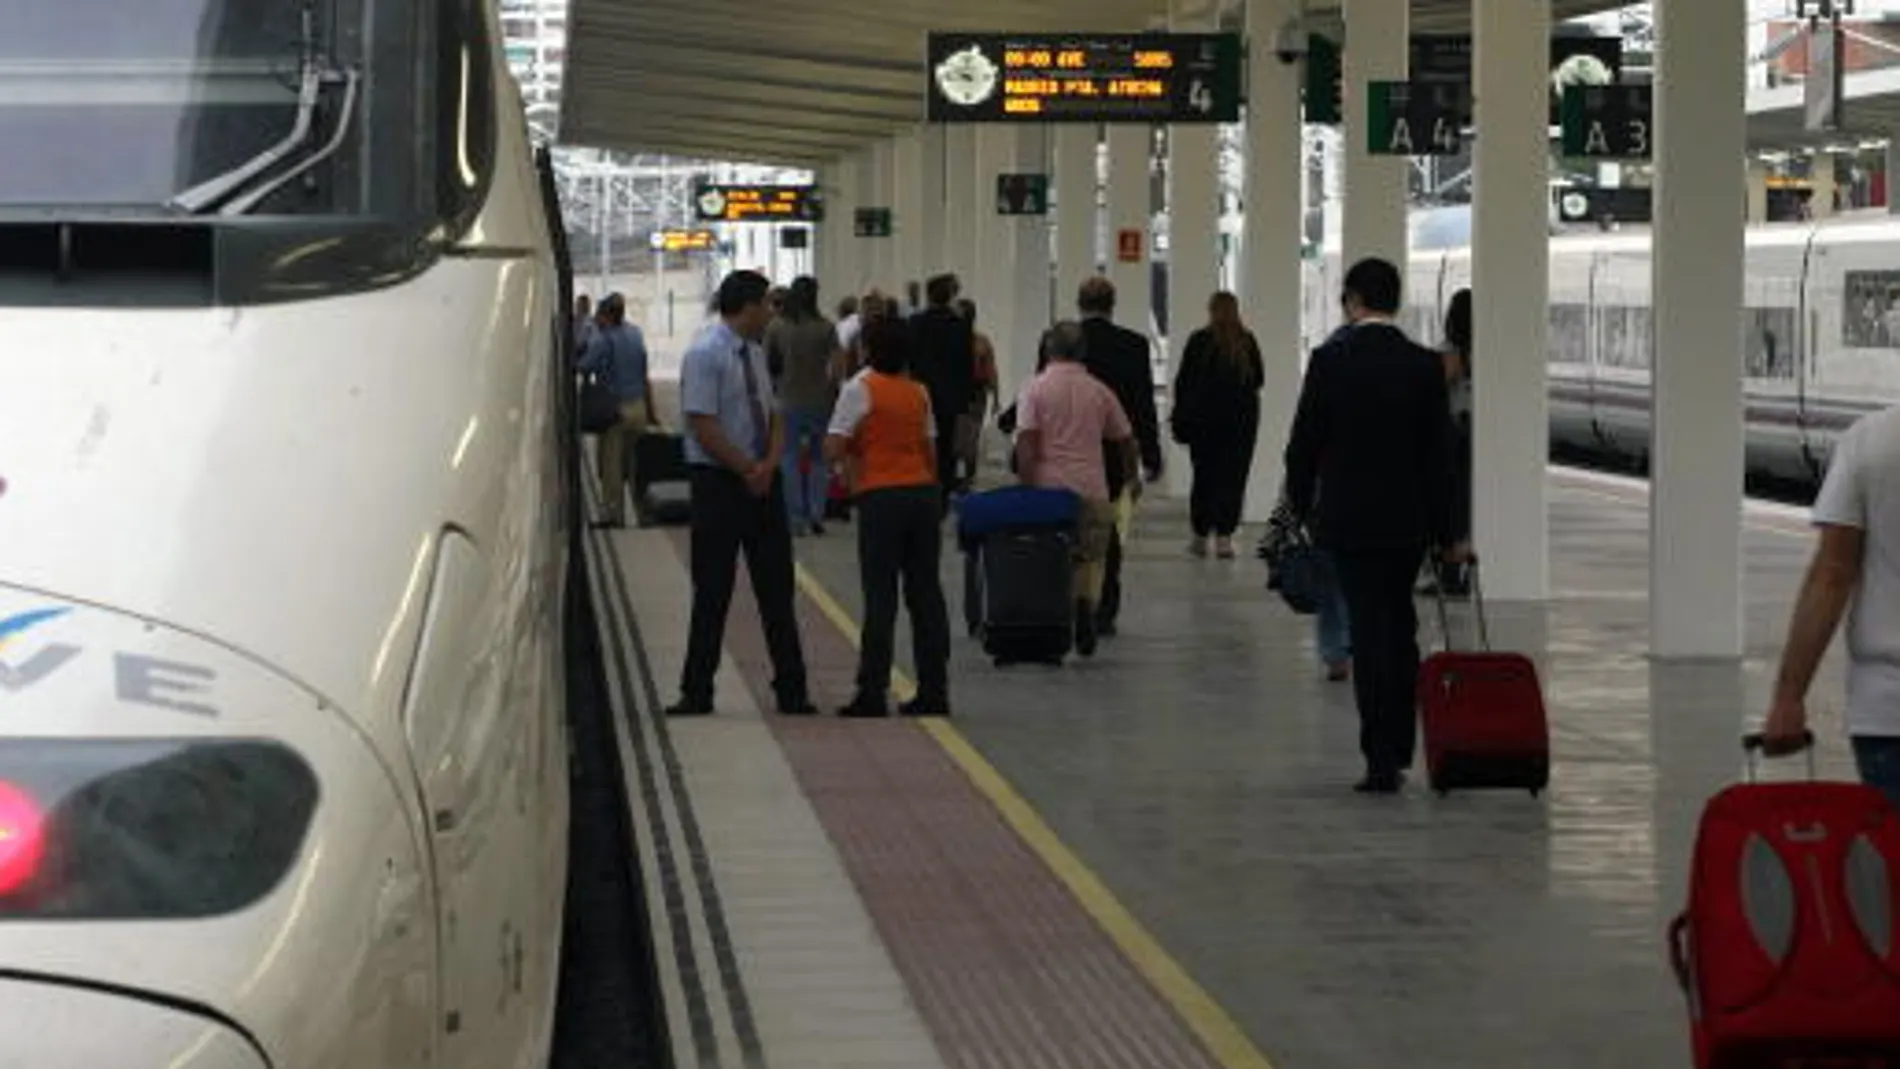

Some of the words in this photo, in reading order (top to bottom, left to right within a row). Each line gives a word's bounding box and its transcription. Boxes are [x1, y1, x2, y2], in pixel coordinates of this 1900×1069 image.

[1190, 78, 1212, 112] 4
[1389, 117, 1412, 151] A
[1433, 117, 1453, 151] 4
[1585, 121, 1609, 153] A
[1627, 121, 1646, 153] 3
